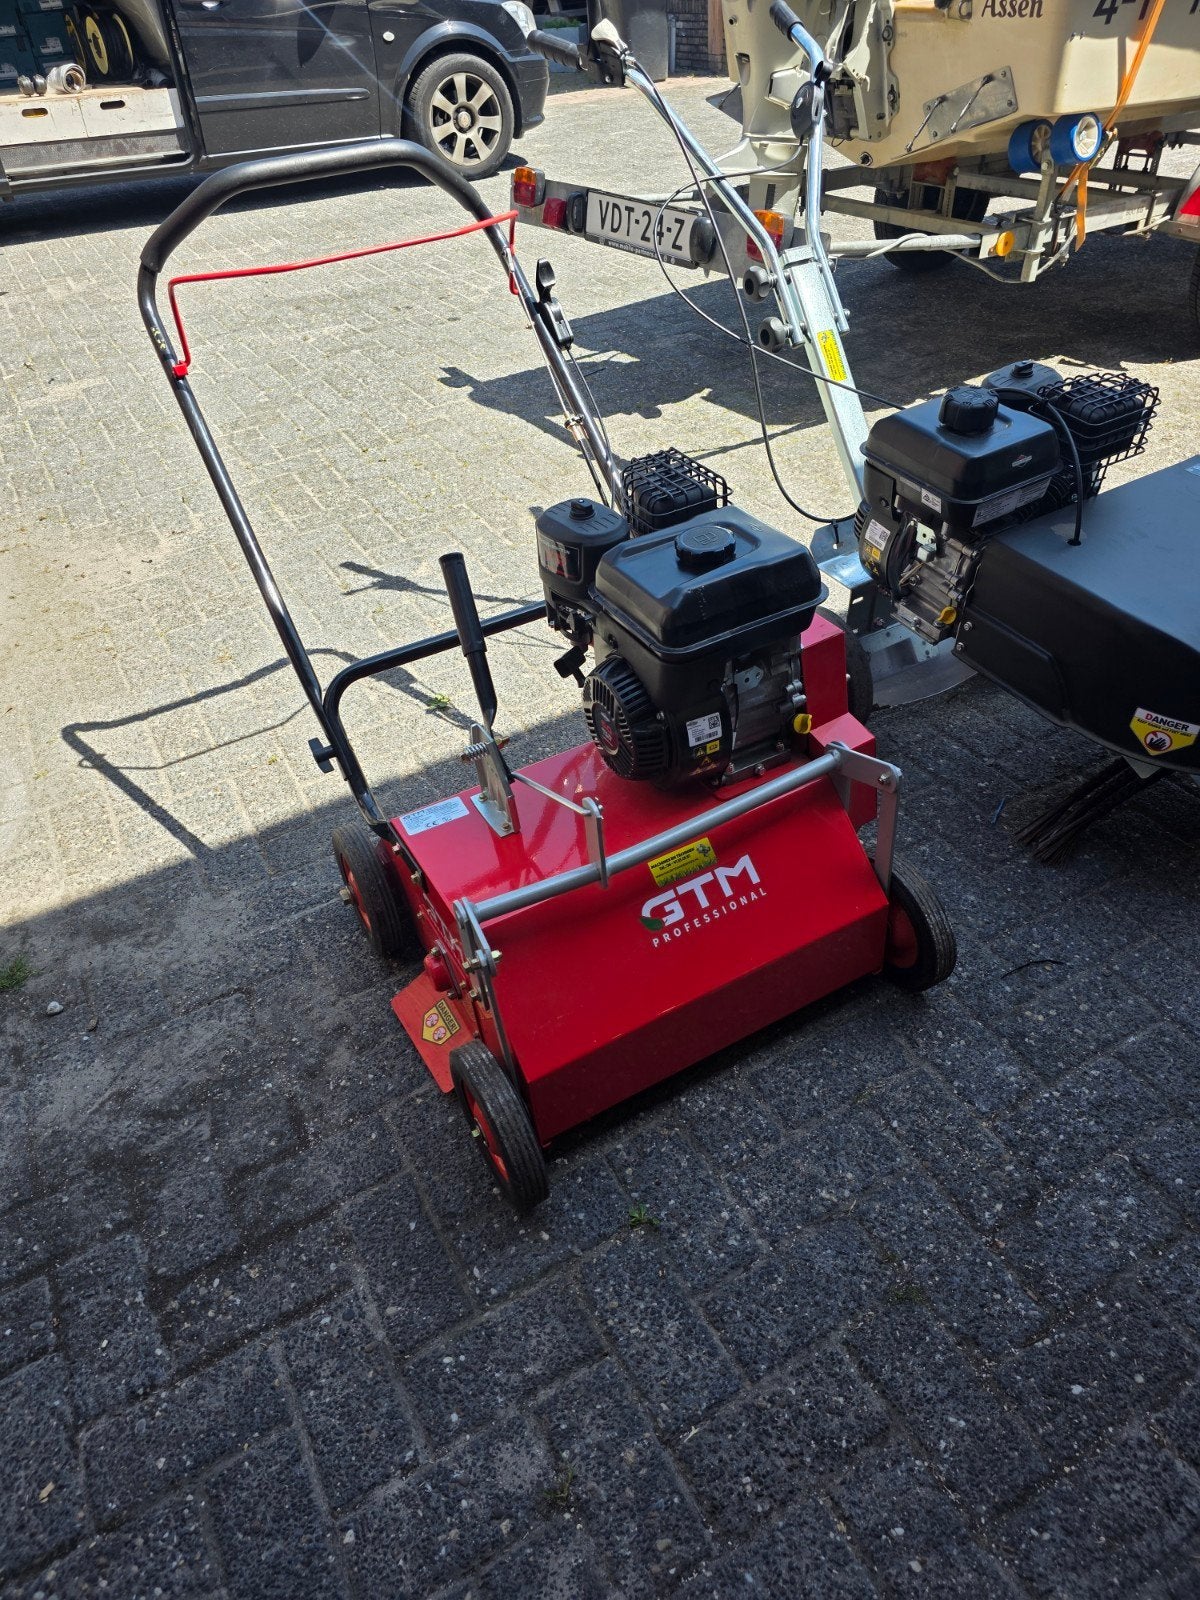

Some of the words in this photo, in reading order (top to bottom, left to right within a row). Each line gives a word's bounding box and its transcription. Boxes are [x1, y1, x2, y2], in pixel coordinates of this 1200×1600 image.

[981, 0, 1043, 18] Assen
[598, 199, 685, 252] VDT-24-Z
[1145, 713, 1190, 731] DANGER
[641, 854, 761, 926] GTM
[652, 887, 767, 948] PROFESSIONAL
